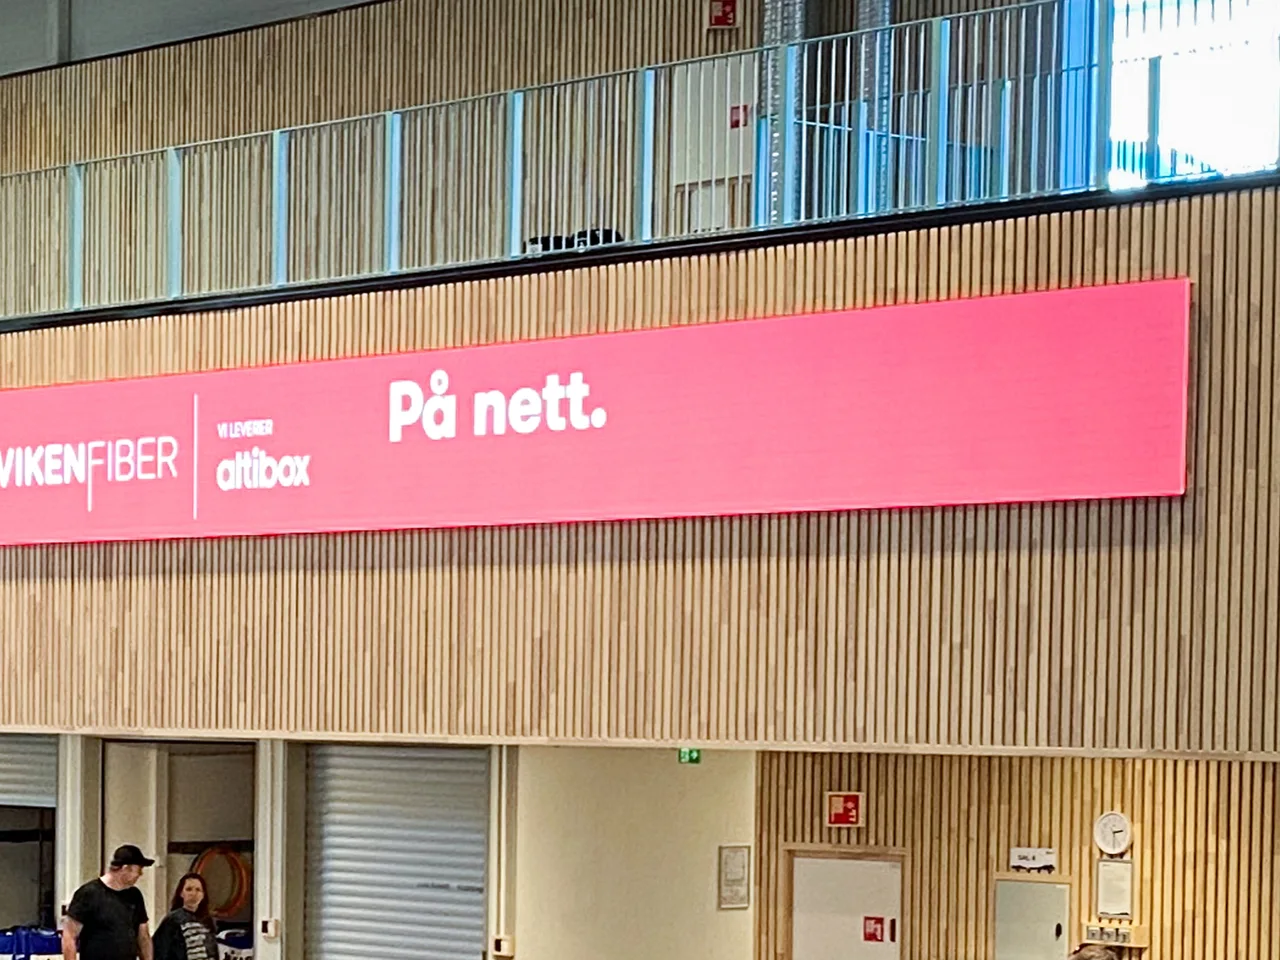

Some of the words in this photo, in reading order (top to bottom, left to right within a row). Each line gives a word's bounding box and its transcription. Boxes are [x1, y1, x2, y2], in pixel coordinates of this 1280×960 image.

[389, 369, 457, 442] På
[473, 371, 607, 436] nett.
[216, 446, 311, 491] altibox
